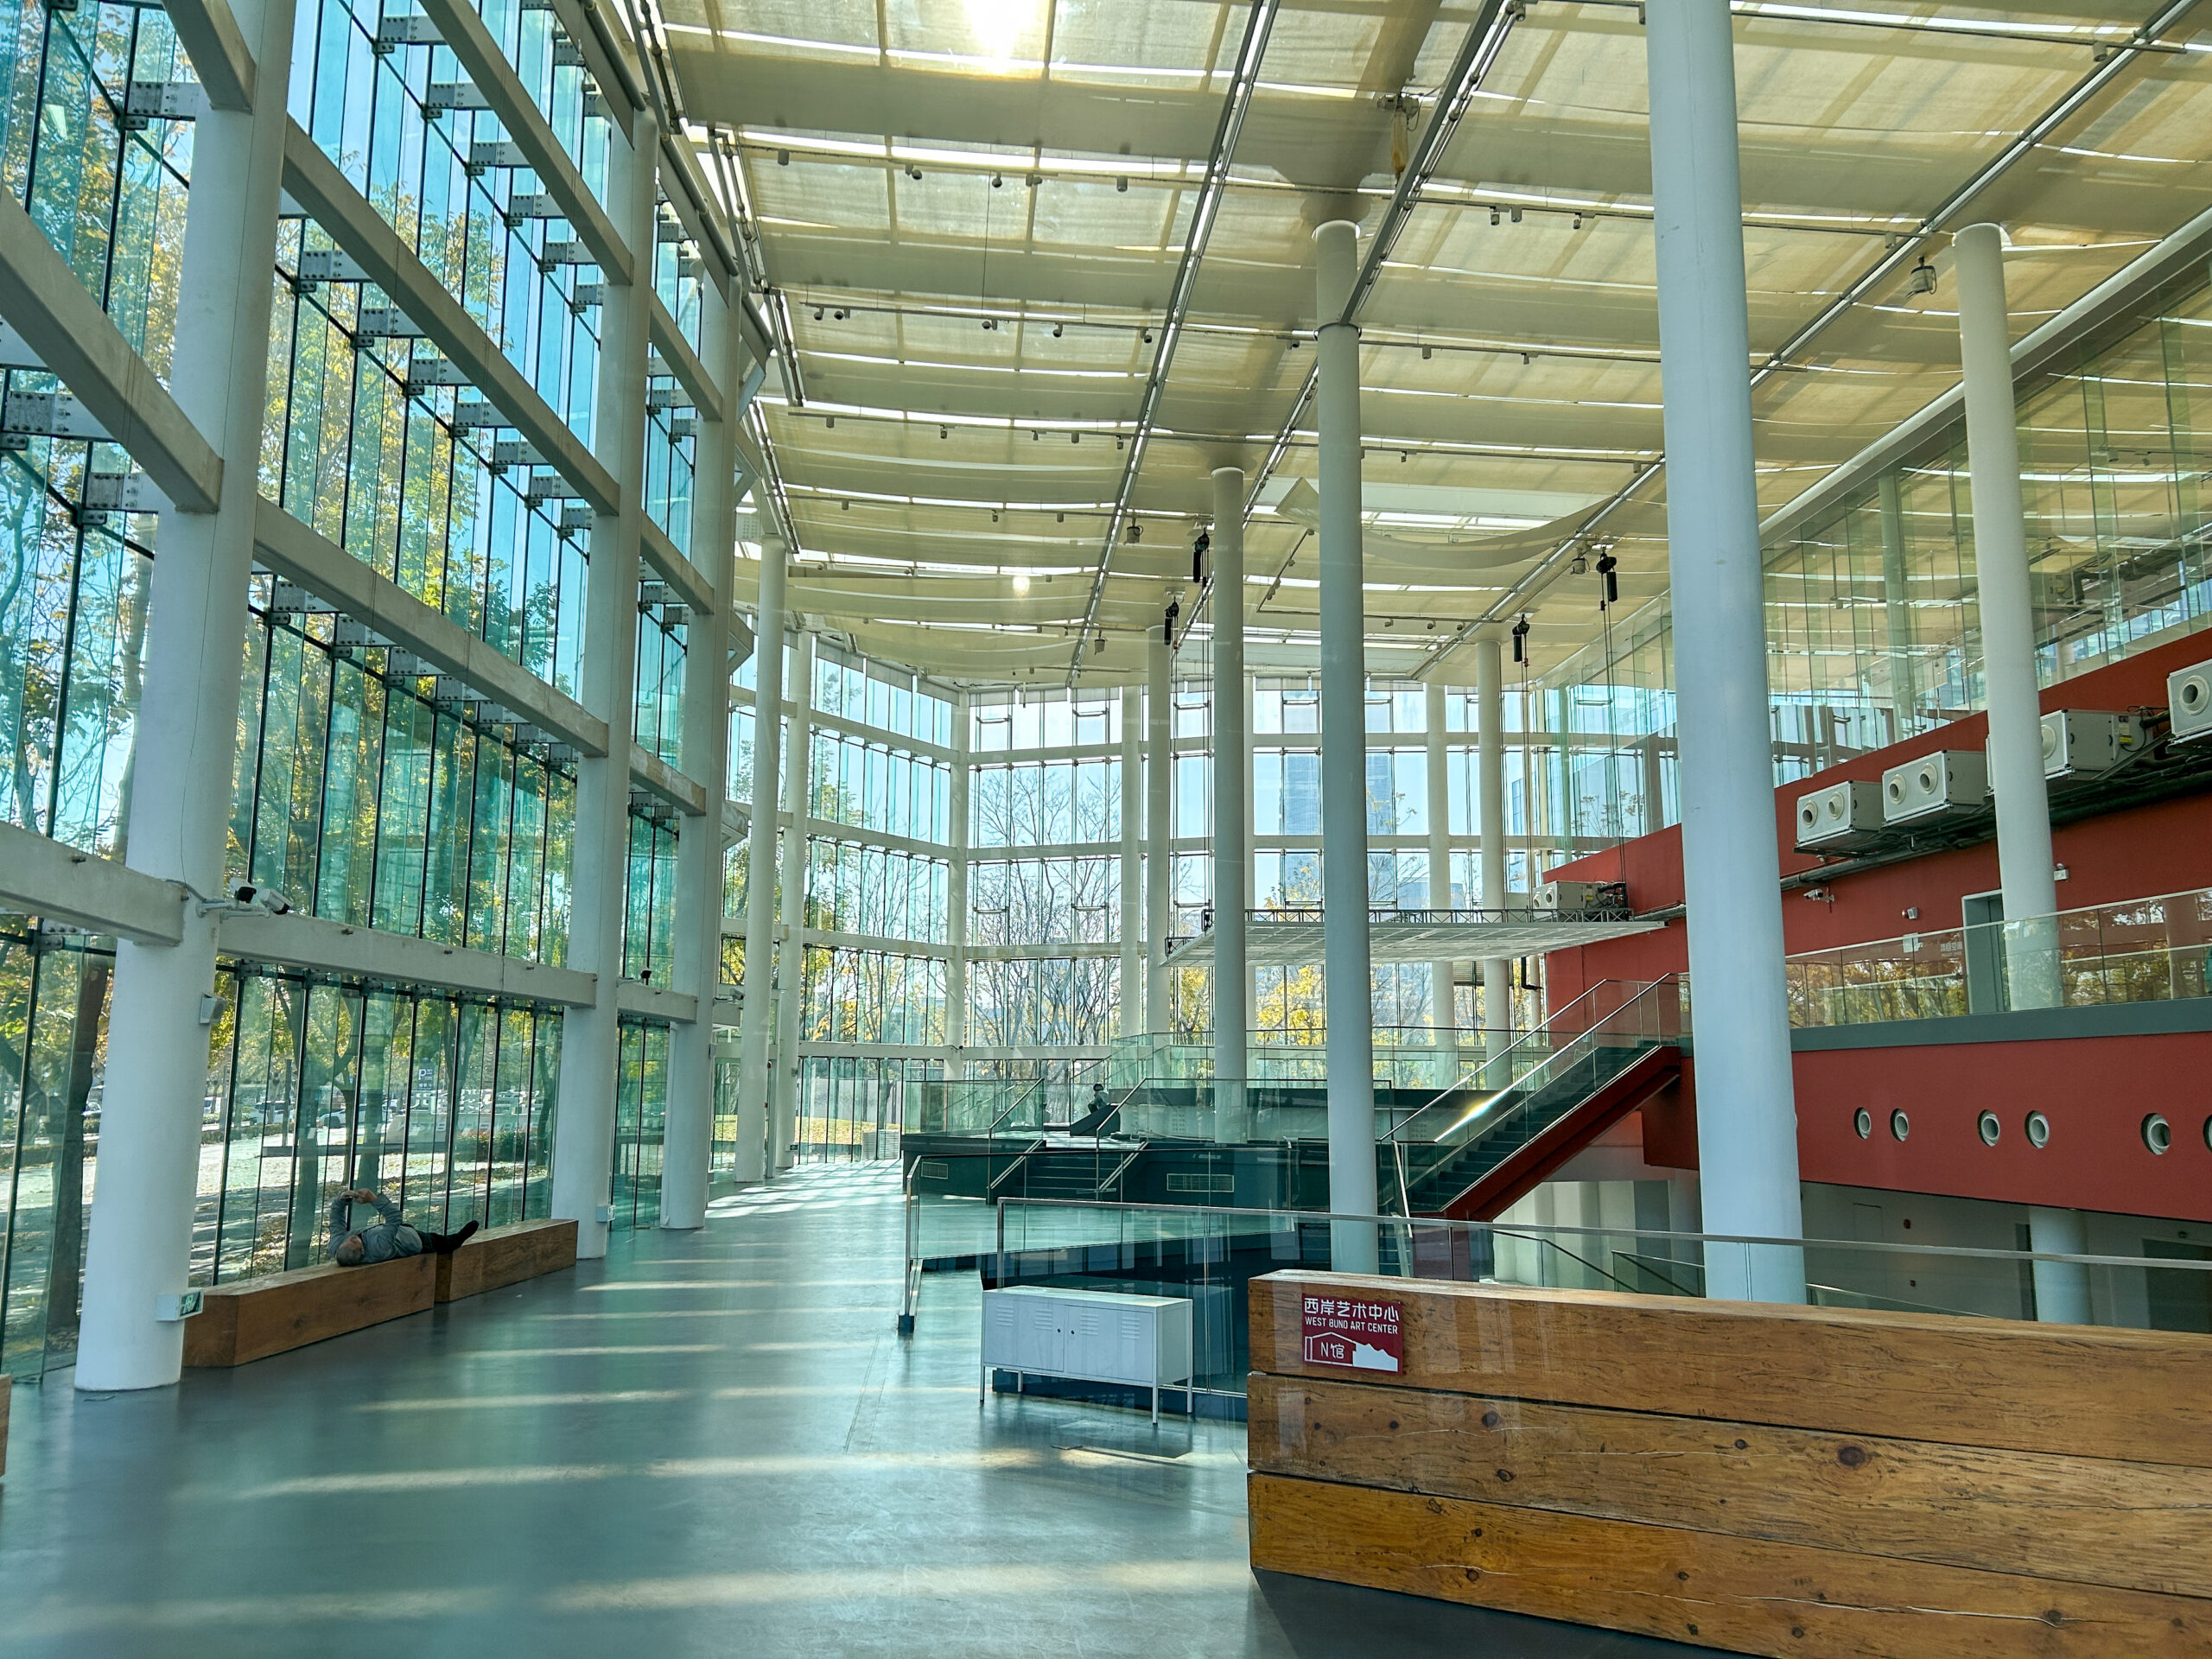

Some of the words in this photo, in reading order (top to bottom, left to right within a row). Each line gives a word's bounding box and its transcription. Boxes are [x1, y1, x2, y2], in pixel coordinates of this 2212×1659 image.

[418, 1068, 427, 1080] P
[1304, 1297, 1400, 1322] 西岸艺术中心
[1305, 1316, 1327, 1327] WEST
[1329, 1318, 1348, 1330] BUND
[1350, 1321, 1366, 1332] ART
[1367, 1322, 1398, 1335] CENTER
